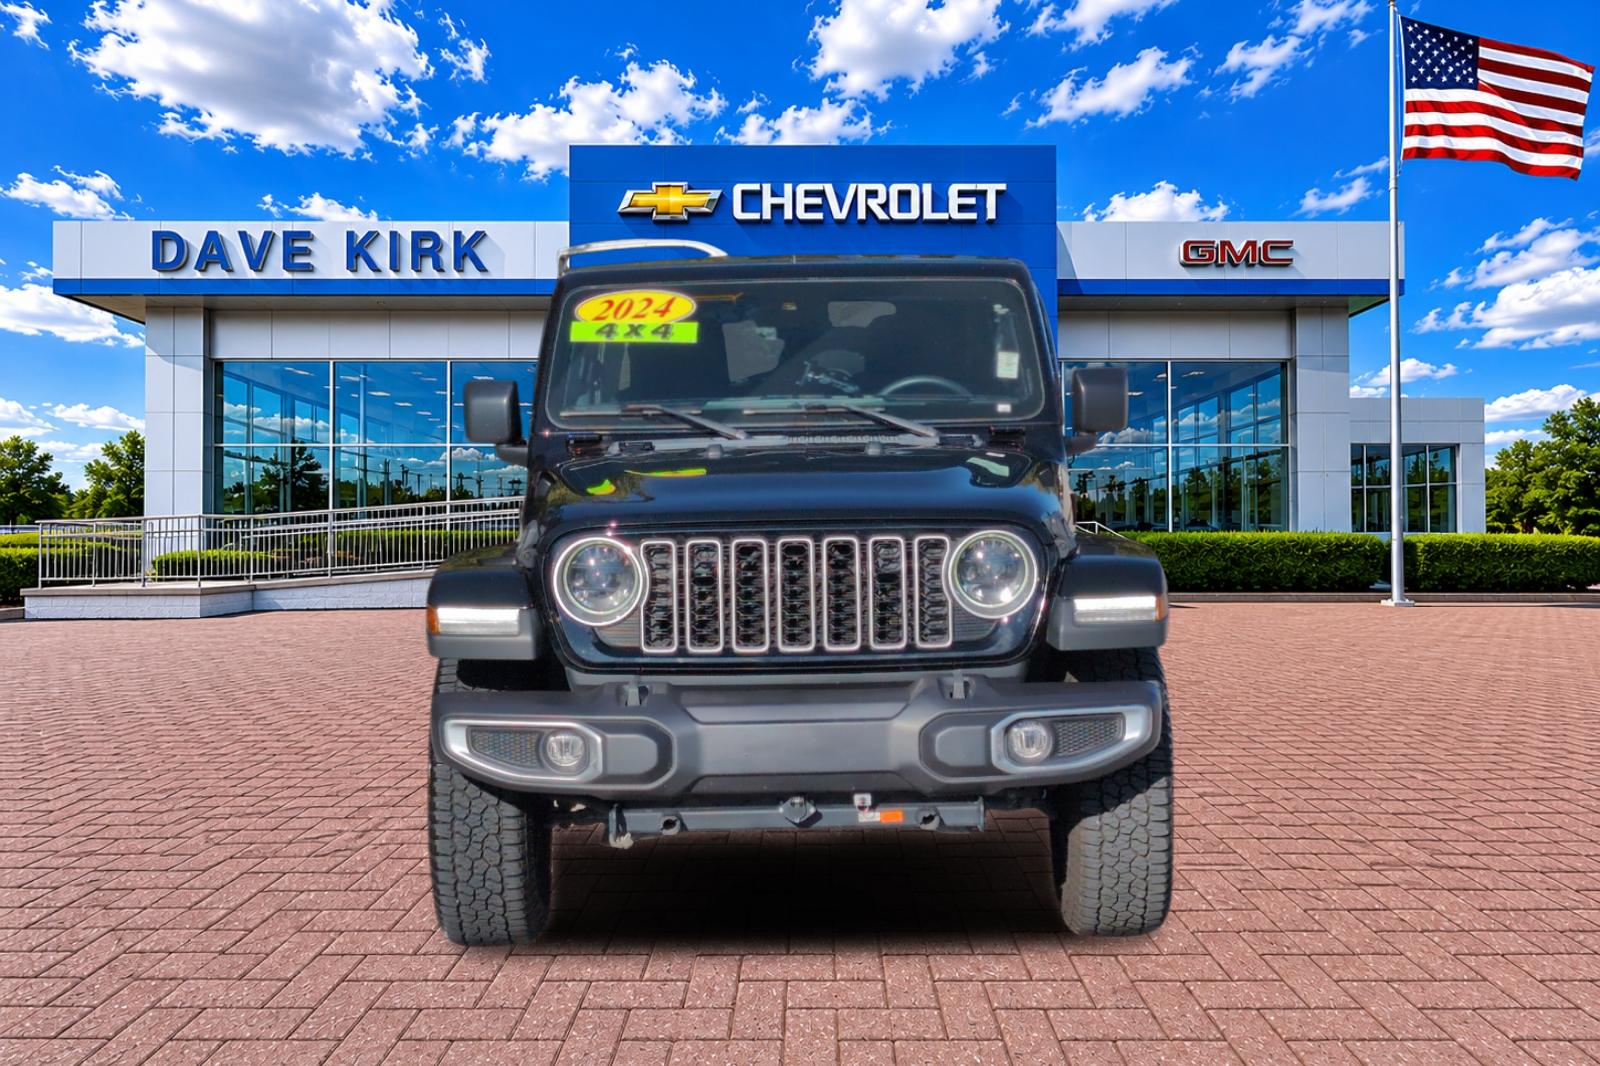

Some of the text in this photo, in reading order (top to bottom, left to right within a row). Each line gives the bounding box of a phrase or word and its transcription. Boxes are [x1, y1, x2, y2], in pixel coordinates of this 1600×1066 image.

[732, 183, 1007, 221] CHEVROLET
[151, 231, 489, 273] DAVE KIRK
[1180, 240, 1294, 266] GMC
[592, 297, 676, 321] 2024
